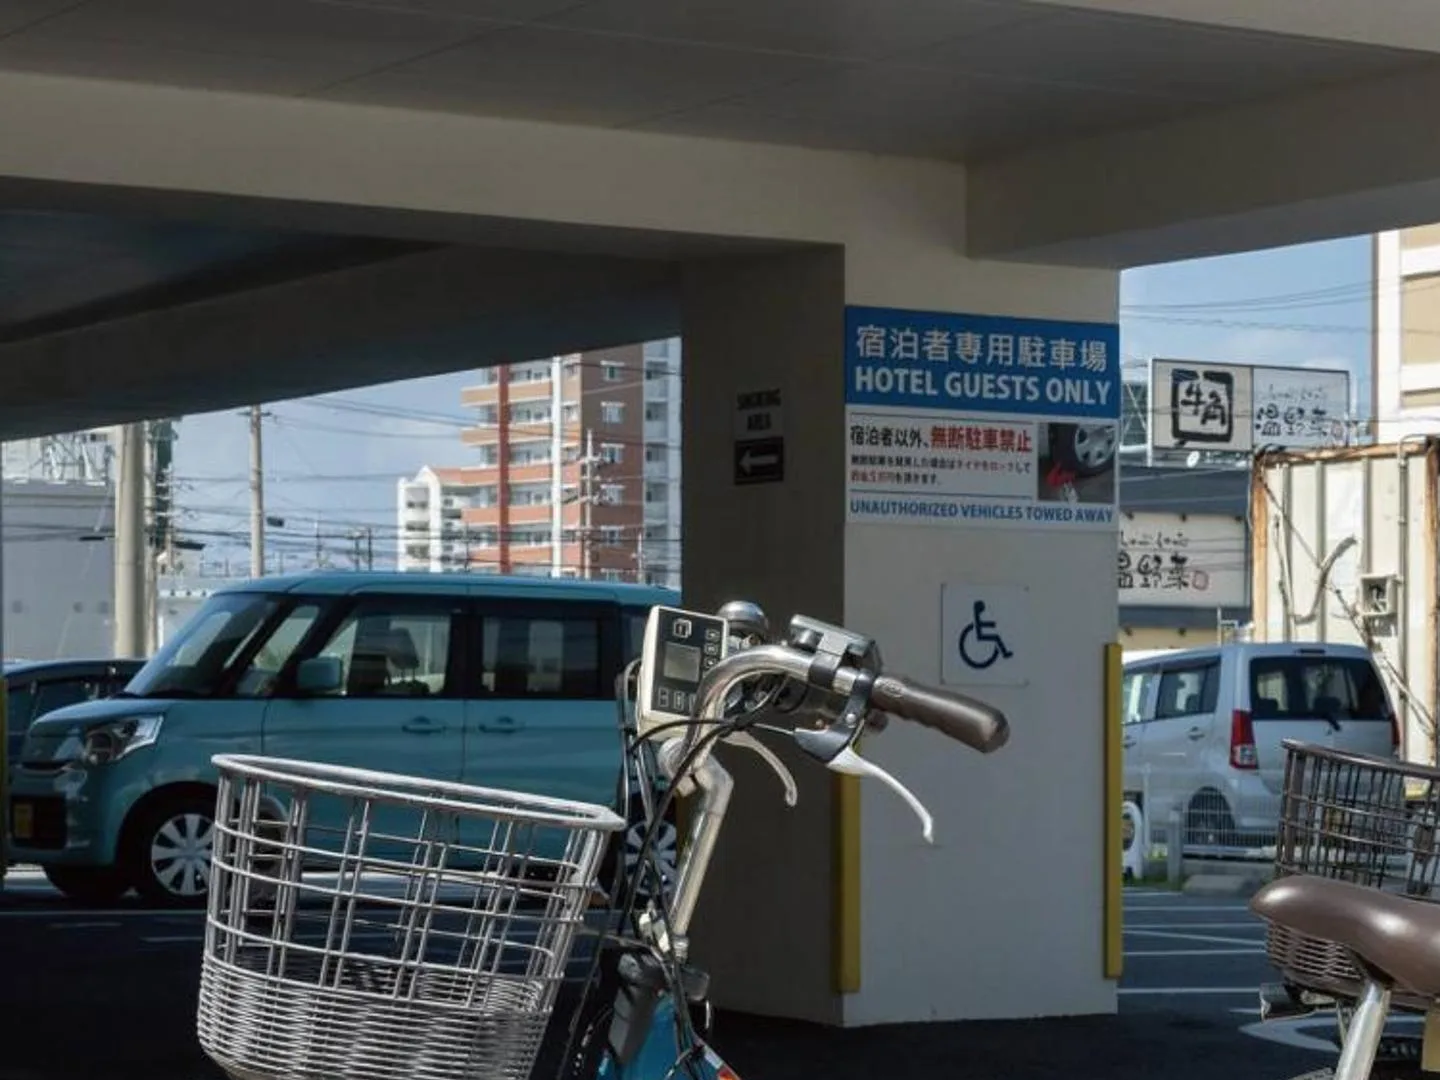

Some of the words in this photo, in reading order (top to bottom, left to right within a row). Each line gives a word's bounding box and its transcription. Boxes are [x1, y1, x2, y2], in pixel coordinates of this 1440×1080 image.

[856, 324, 1108, 372] 宿泊者専用駐車場
[855, 366, 938, 396] HOTEL
[944, 371, 1040, 401] GUESTS
[1046, 378, 1112, 405] ONLY
[1180, 383, 1227, 426] 牛角
[1255, 402, 1328, 437] 温野菜
[850, 499, 958, 518] UNAUTHORIZED
[962, 503, 1022, 520] VEHICLES
[1026, 506, 1073, 522] TOWED
[1075, 508, 1113, 523] AWAY
